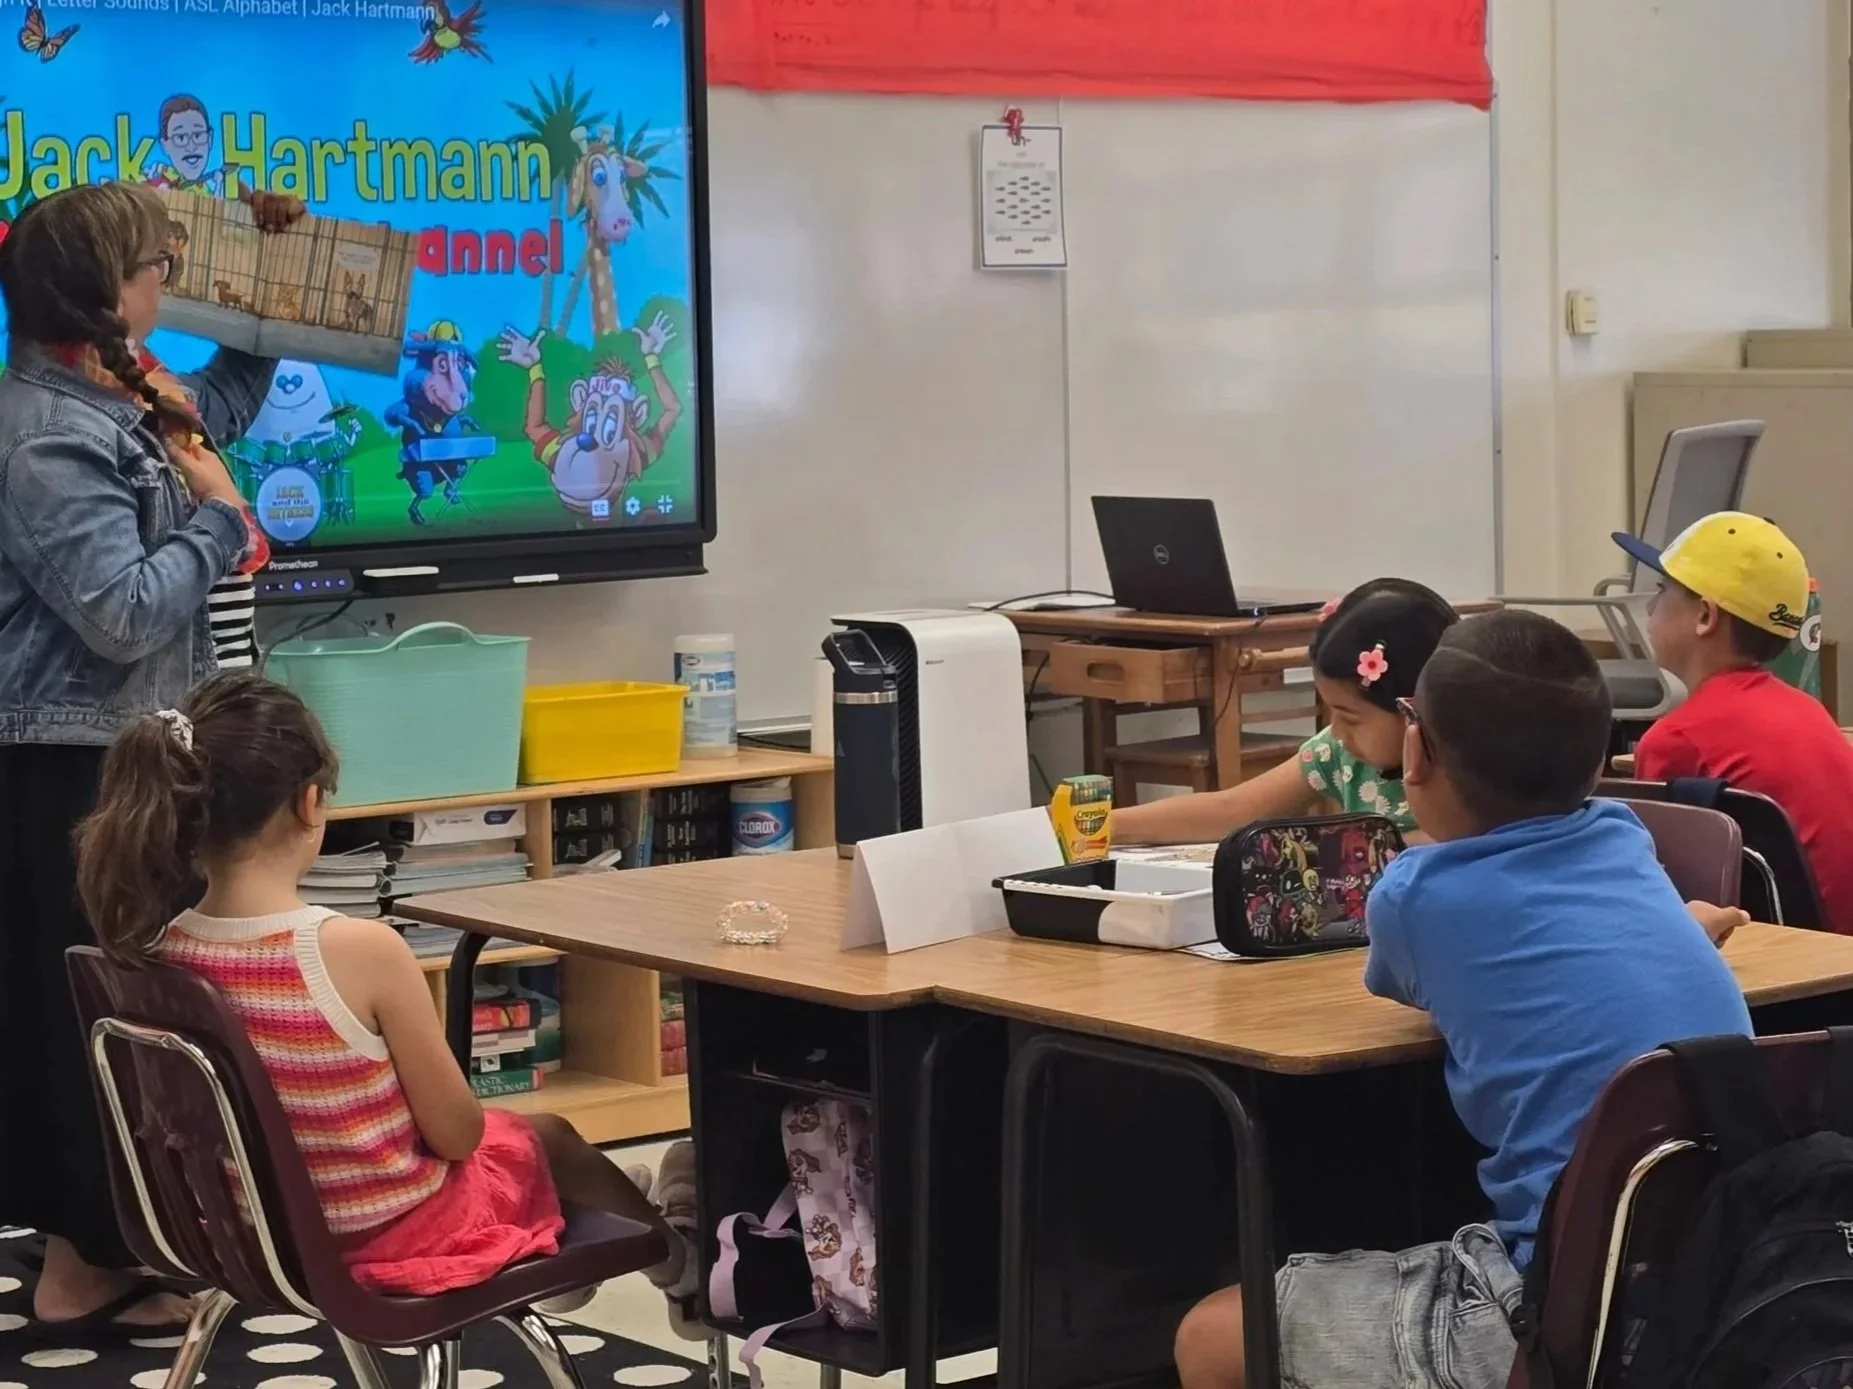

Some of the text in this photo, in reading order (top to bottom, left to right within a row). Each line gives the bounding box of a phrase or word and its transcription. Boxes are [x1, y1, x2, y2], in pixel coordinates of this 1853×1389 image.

[104, 0, 169, 11] Sounds
[183, 0, 219, 13] ASL
[222, 0, 299, 17] Alphabet
[311, 2, 351, 17] Jack
[354, 3, 436, 20] Hartmann
[0, 109, 552, 202] Jack Hartmann
[416, 217, 565, 277] annel
[738, 820, 776, 836] CLOROX
